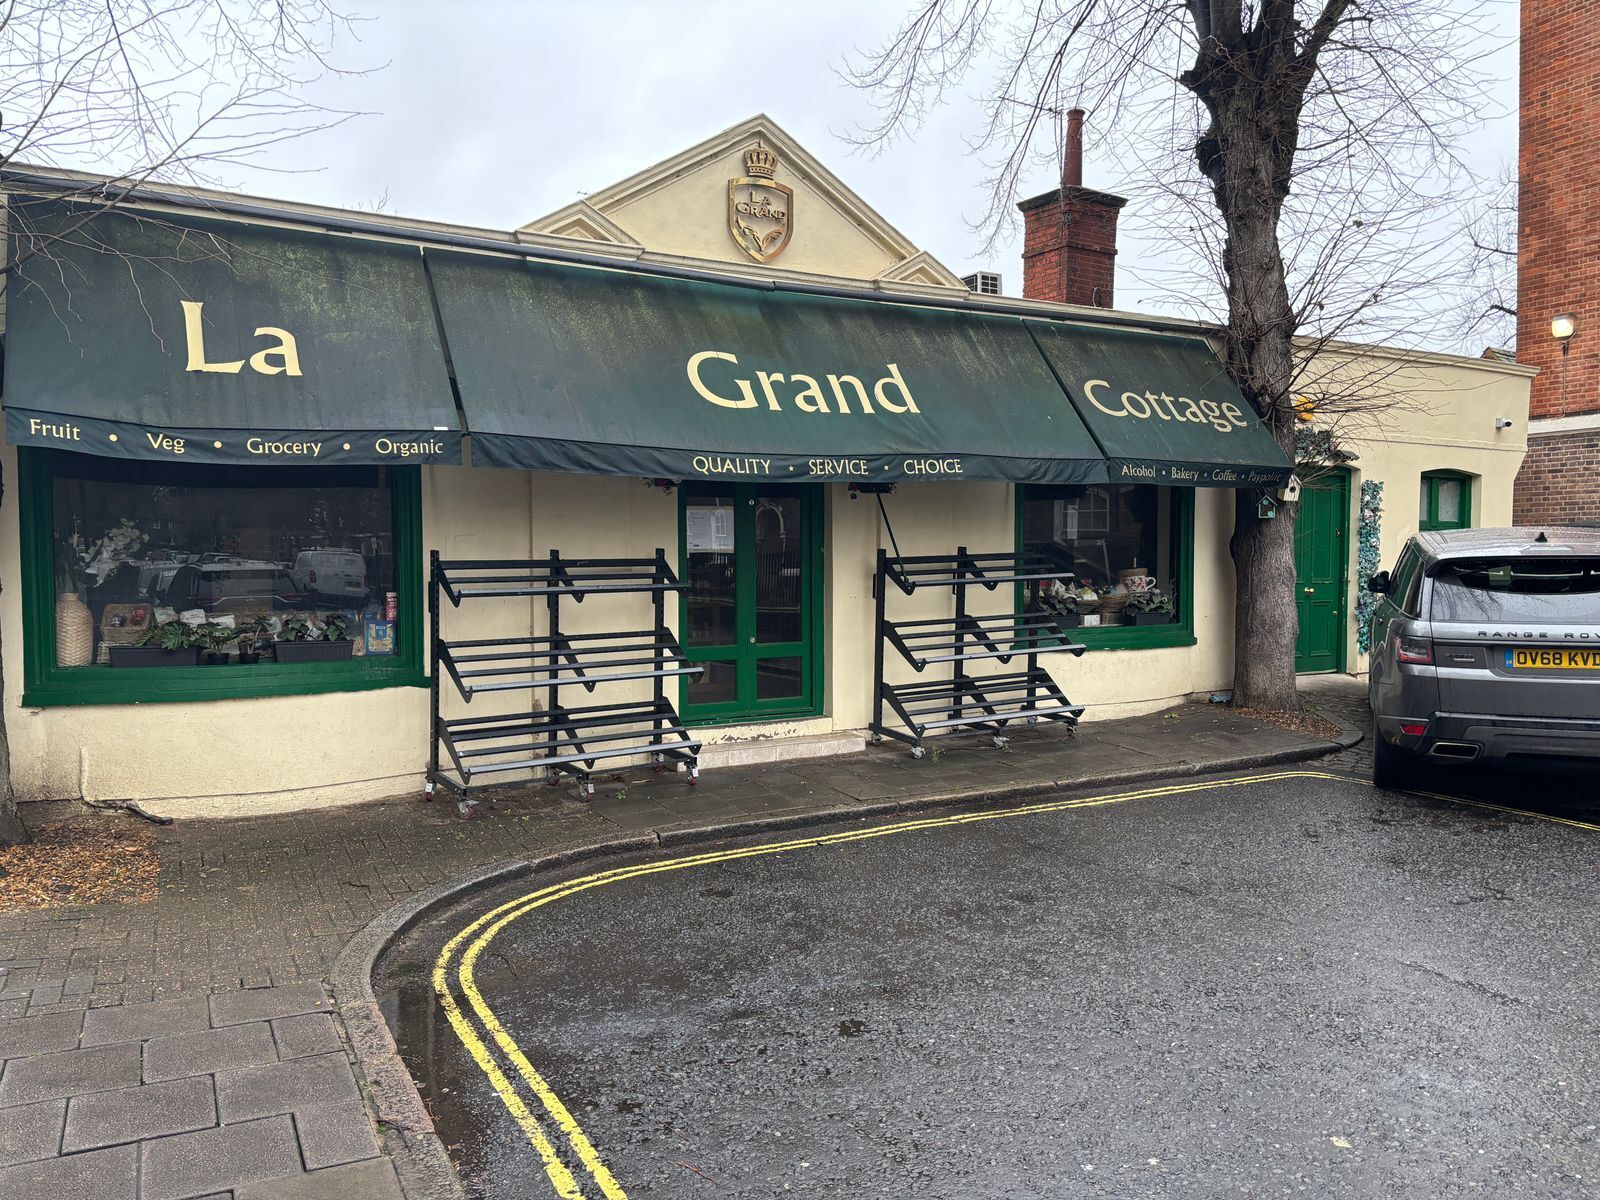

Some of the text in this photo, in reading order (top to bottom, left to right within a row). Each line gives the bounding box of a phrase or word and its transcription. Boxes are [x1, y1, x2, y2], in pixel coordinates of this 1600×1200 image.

[750, 190, 772, 205] LA
[735, 202, 786, 220] GRAND
[180, 300, 1248, 433] La Grand Cottage
[29, 418, 444, 460] Fruit Veg Grocery Organic
[692, 455, 963, 476] QUALITY SERVICE CHOICE
[1121, 464, 1156, 478] Alcohol
[1171, 466, 1200, 482] Bakery
[1212, 468, 1238, 481] Coffee
[1477, 630, 1549, 639] RANGE
[1516, 650, 1563, 666] OV68
